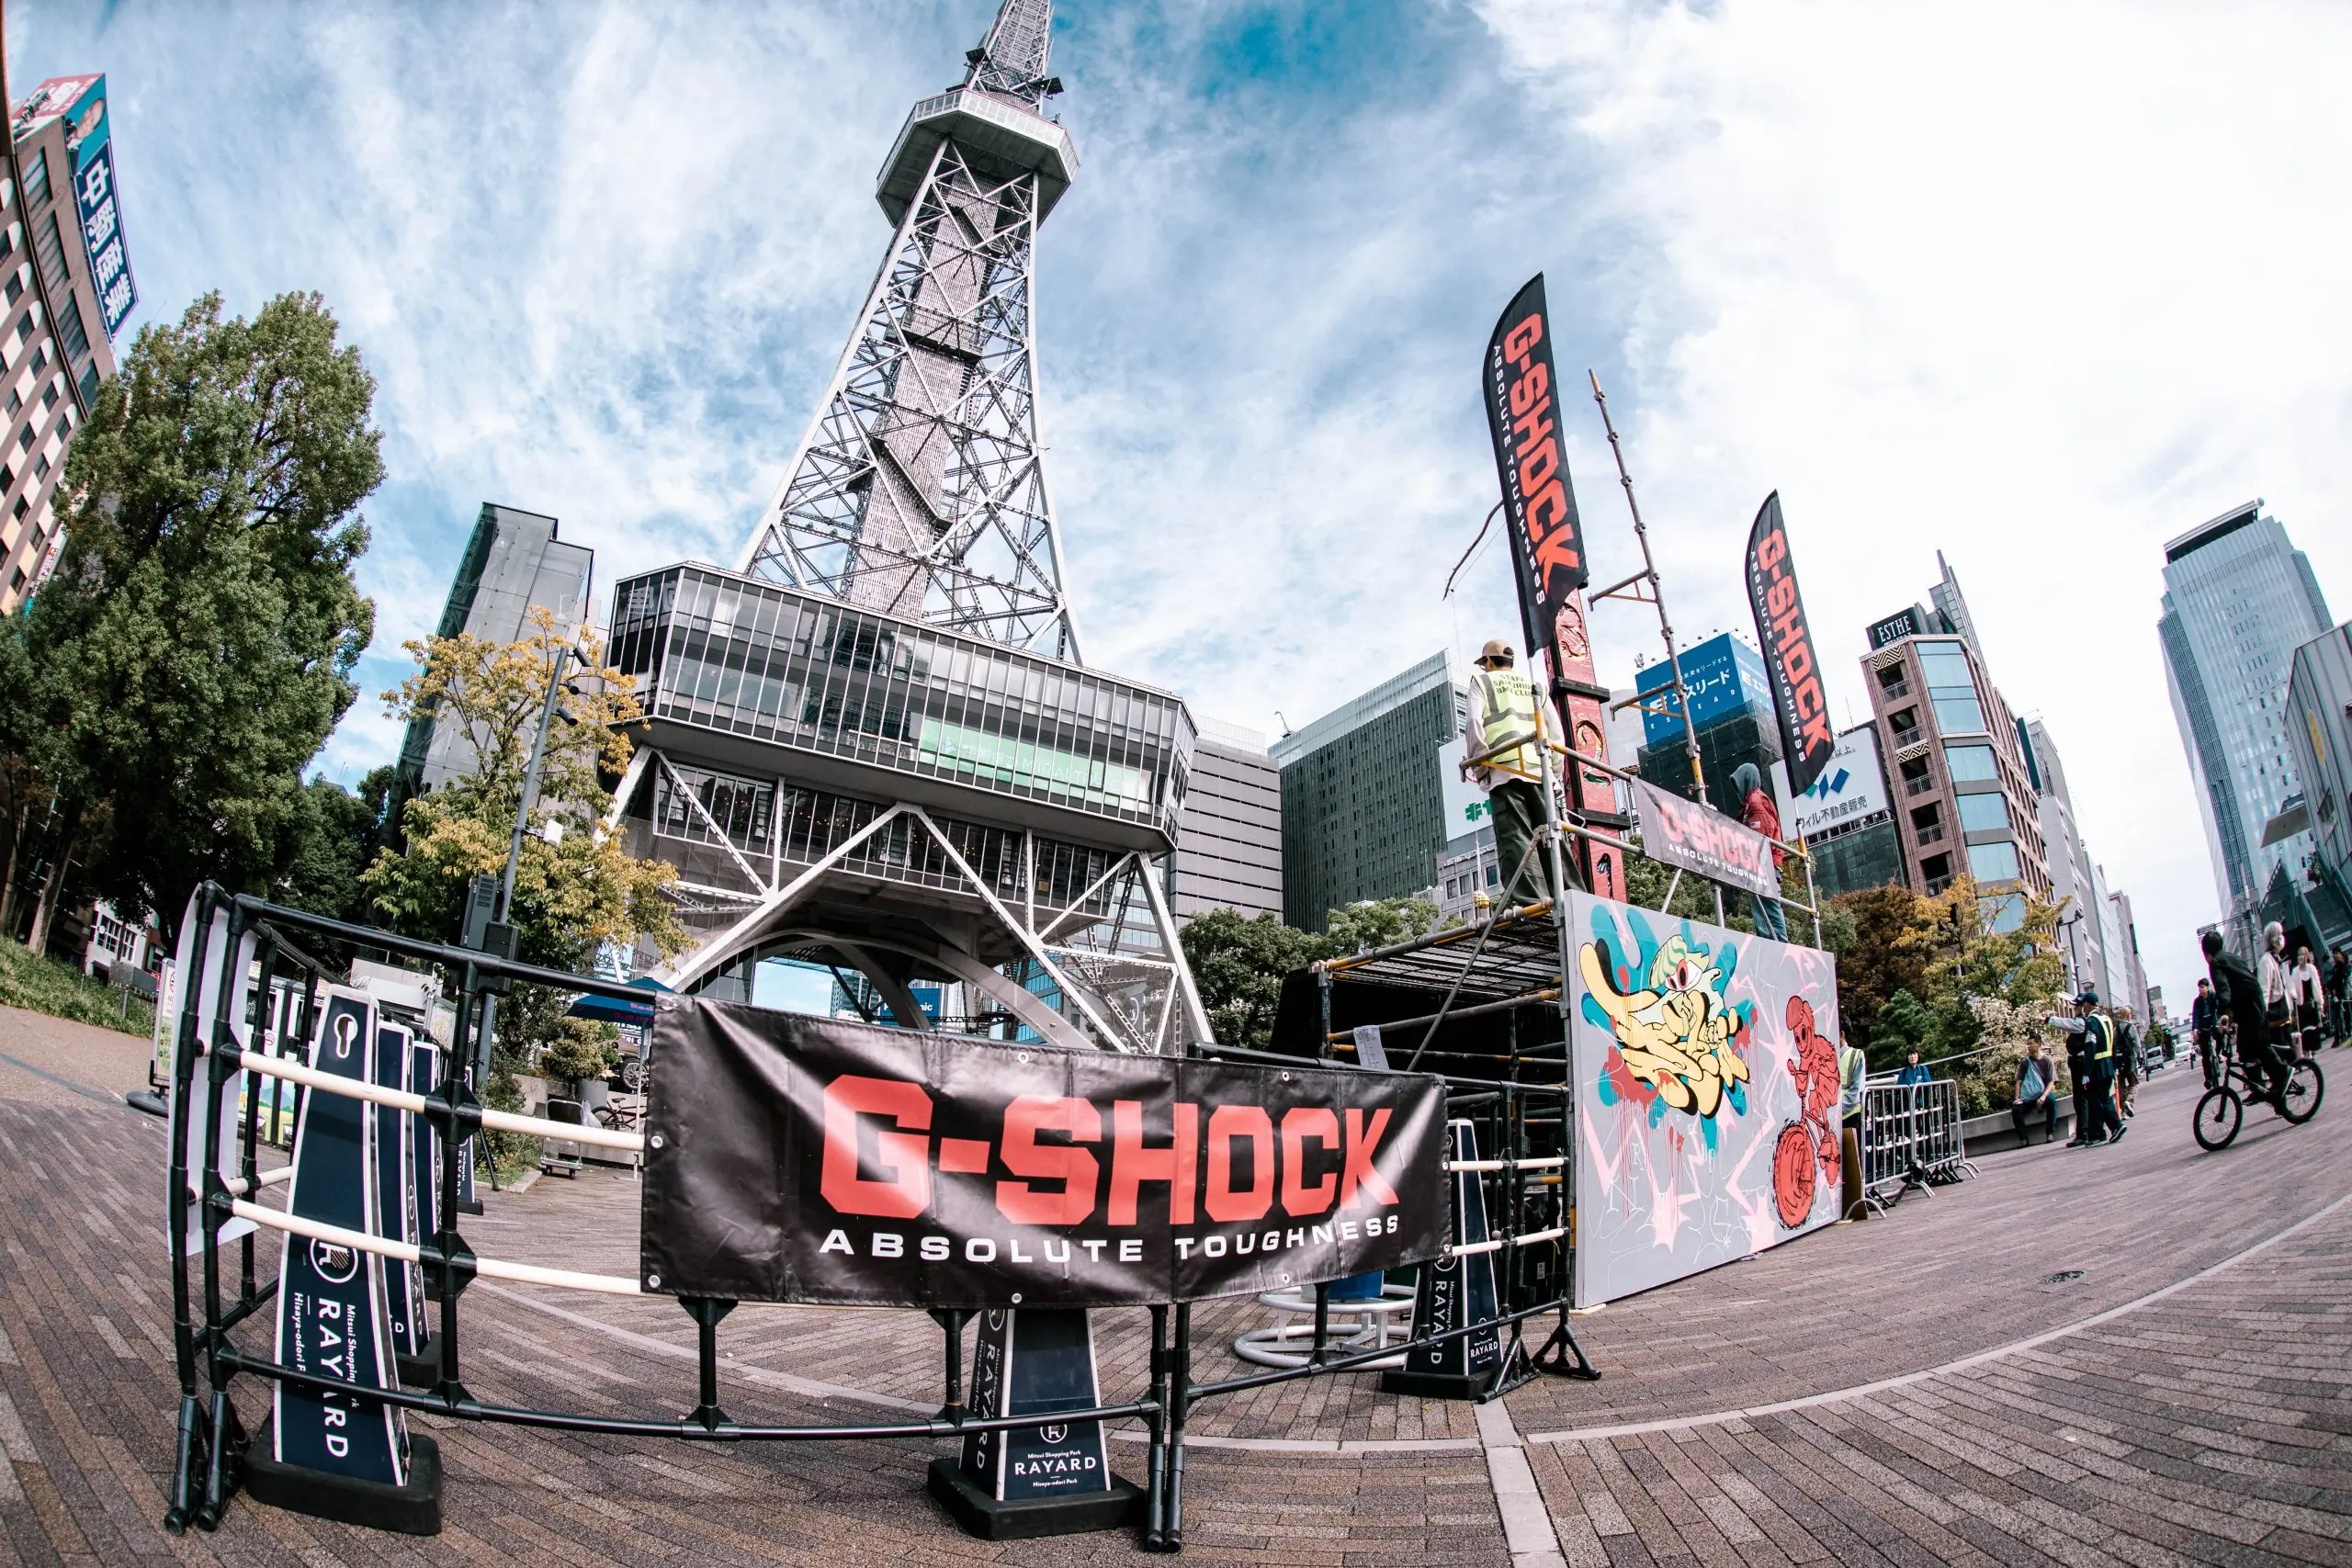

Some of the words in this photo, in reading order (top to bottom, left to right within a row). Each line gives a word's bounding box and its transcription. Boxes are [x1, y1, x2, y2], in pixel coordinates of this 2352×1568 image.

[83, 159, 131, 326] 中駒産業
[1493, 344, 1511, 447] ABSOLUTE
[1507, 455, 1545, 605] TOUGHNESS
[1504, 312, 1580, 595] G-SHOCK
[1750, 551, 1773, 641] ABSOLUTE
[1773, 649, 1806, 762] TOUGHNESS
[1758, 529, 1831, 758] G-SHOCK
[1877, 615, 1911, 643] ESTHE
[1651, 690, 1735, 729] ESEAD
[1668, 843, 1719, 868] ABSOLUTE
[1722, 862, 1769, 886] TOUGHNESS
[820, 1074, 1401, 1225] G-SHOCK
[819, 1229, 1144, 1263] ABSOLUTE
[1174, 1214, 1400, 1260] TOUGHNESS
[292, 1292, 305, 1361] Hisaya-odori
[346, 1304, 356, 1337] Mitsui
[1470, 1341, 1498, 1359] RAYARD
[318, 1298, 349, 1458] RAYRD
[977, 1344, 996, 1470] RAYARD
[1014, 1457, 1096, 1475] RAYARD
[1033, 1479, 1066, 1488] Hisaya-odori
